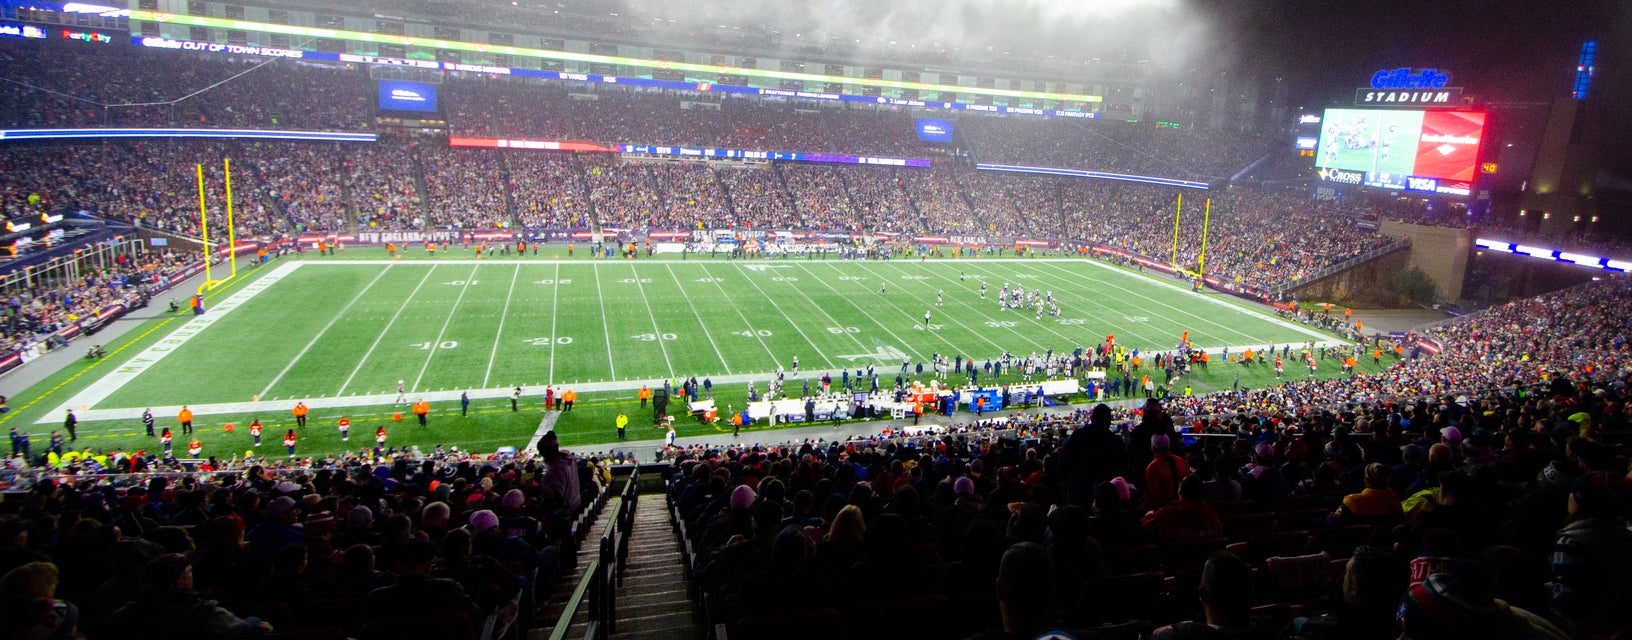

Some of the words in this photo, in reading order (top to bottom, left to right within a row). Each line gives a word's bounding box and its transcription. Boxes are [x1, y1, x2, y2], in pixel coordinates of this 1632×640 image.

[183, 41, 207, 51] OUT
[208, 42, 226, 52] OF
[227, 44, 260, 55] TOWN
[260, 47, 304, 58] SCORES
[1371, 67, 1449, 89] Gillette
[1364, 92, 1450, 103] STADIUM
[1483, 162, 1498, 172] 40
[1328, 168, 1362, 182] CROSS
[1408, 177, 1437, 191] VISA
[741, 329, 773, 338] 40
[827, 326, 861, 335] 50
[531, 336, 573, 346] 20
[638, 333, 678, 342] 30
[420, 341, 458, 350] 10
